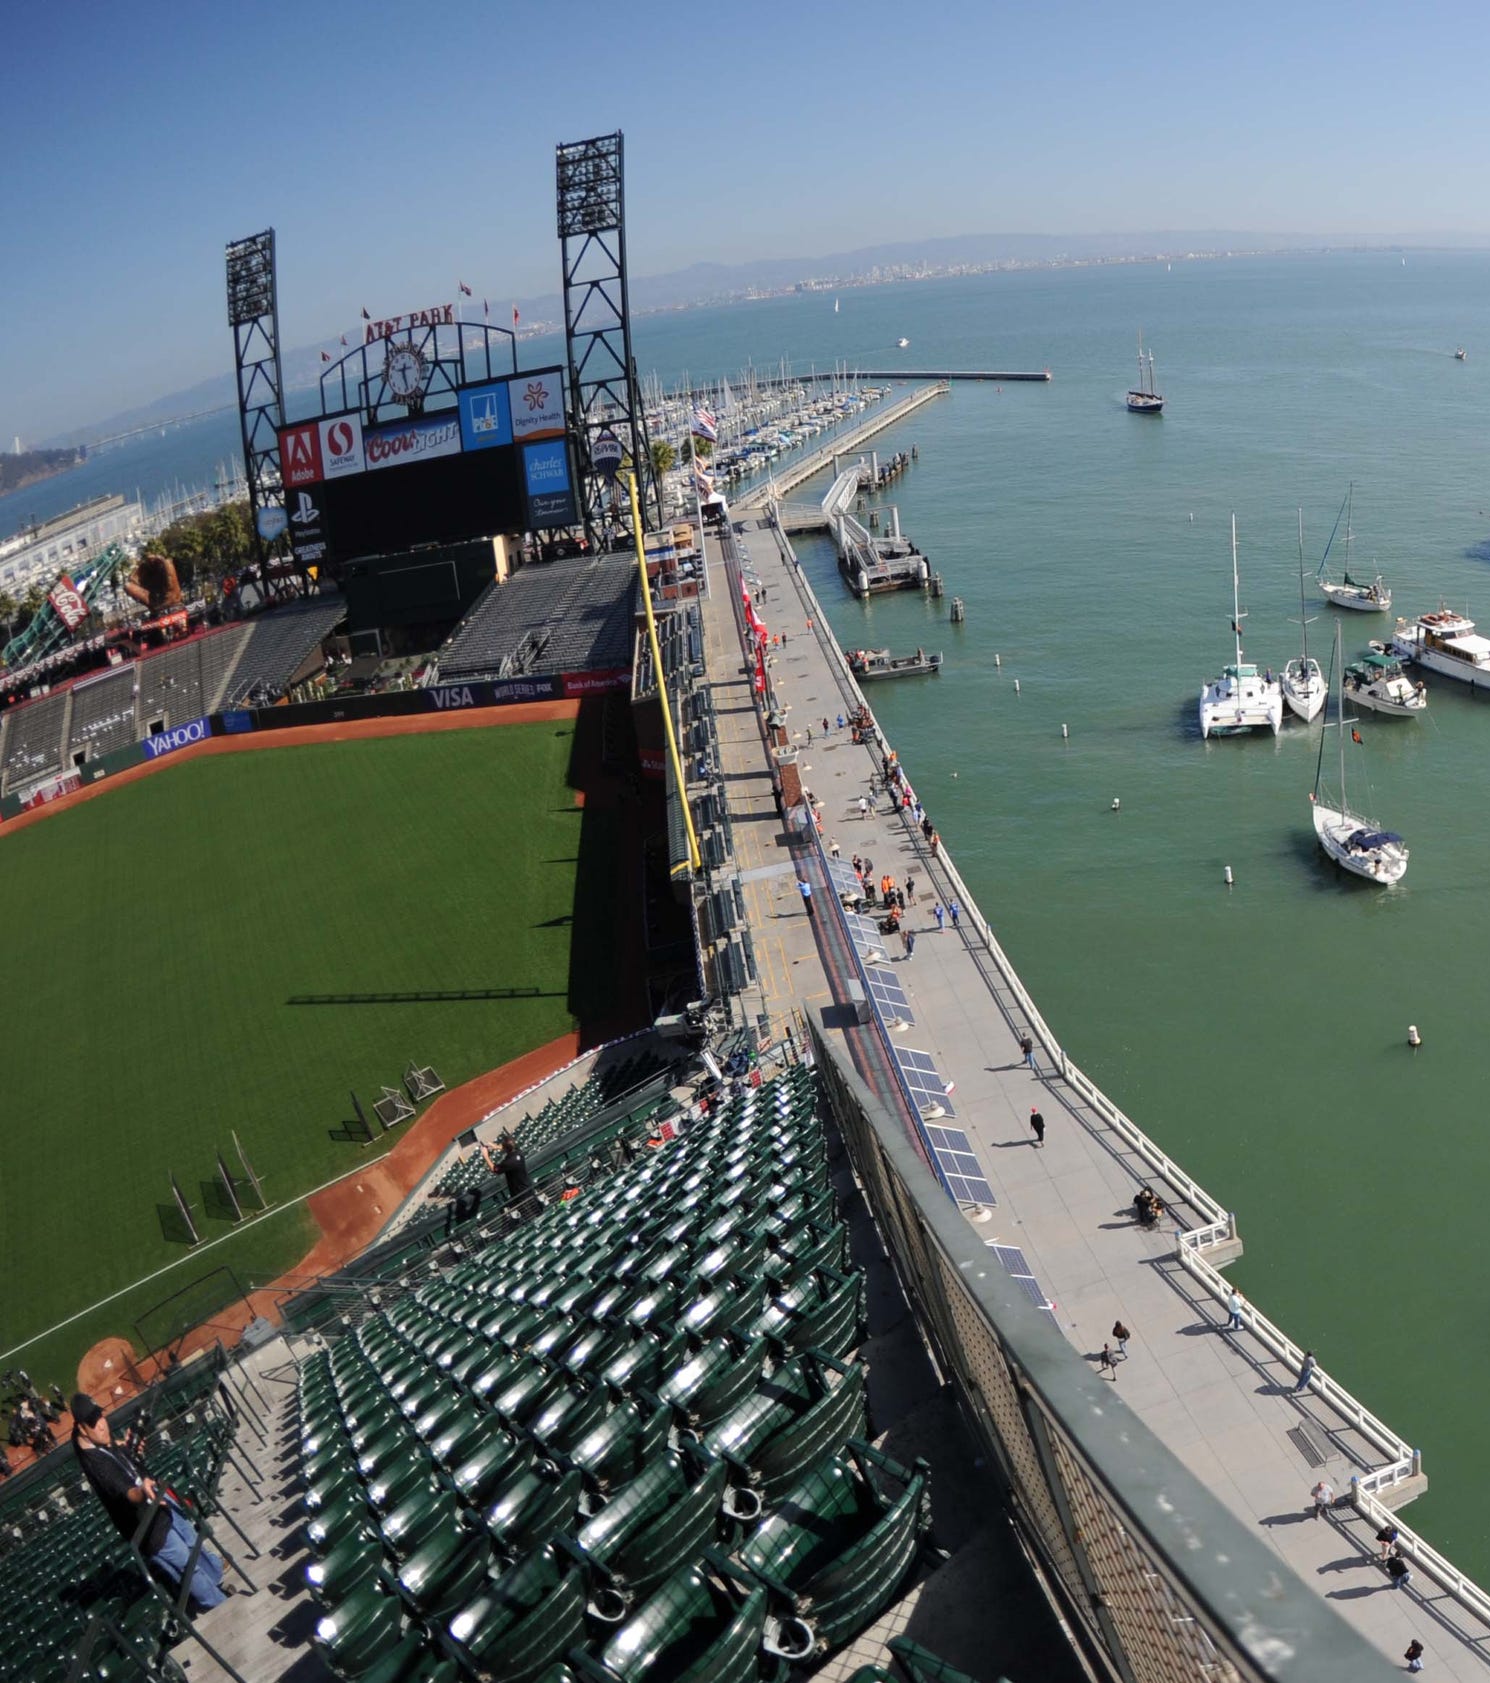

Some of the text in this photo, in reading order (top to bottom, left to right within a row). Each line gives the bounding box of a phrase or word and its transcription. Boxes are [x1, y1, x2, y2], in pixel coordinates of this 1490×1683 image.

[366, 304, 454, 345] AT&T PARK
[515, 411, 561, 427] Dignity Health
[367, 421, 457, 463] Coors LIGHT
[329, 455, 355, 466] SAFEWAY
[292, 468, 314, 483] Adobe
[536, 683, 553, 693] FOX
[567, 681, 584, 690] Bank
[590, 679, 617, 688] America
[430, 687, 474, 708] VISA
[147, 719, 205, 756] YAHOO!
